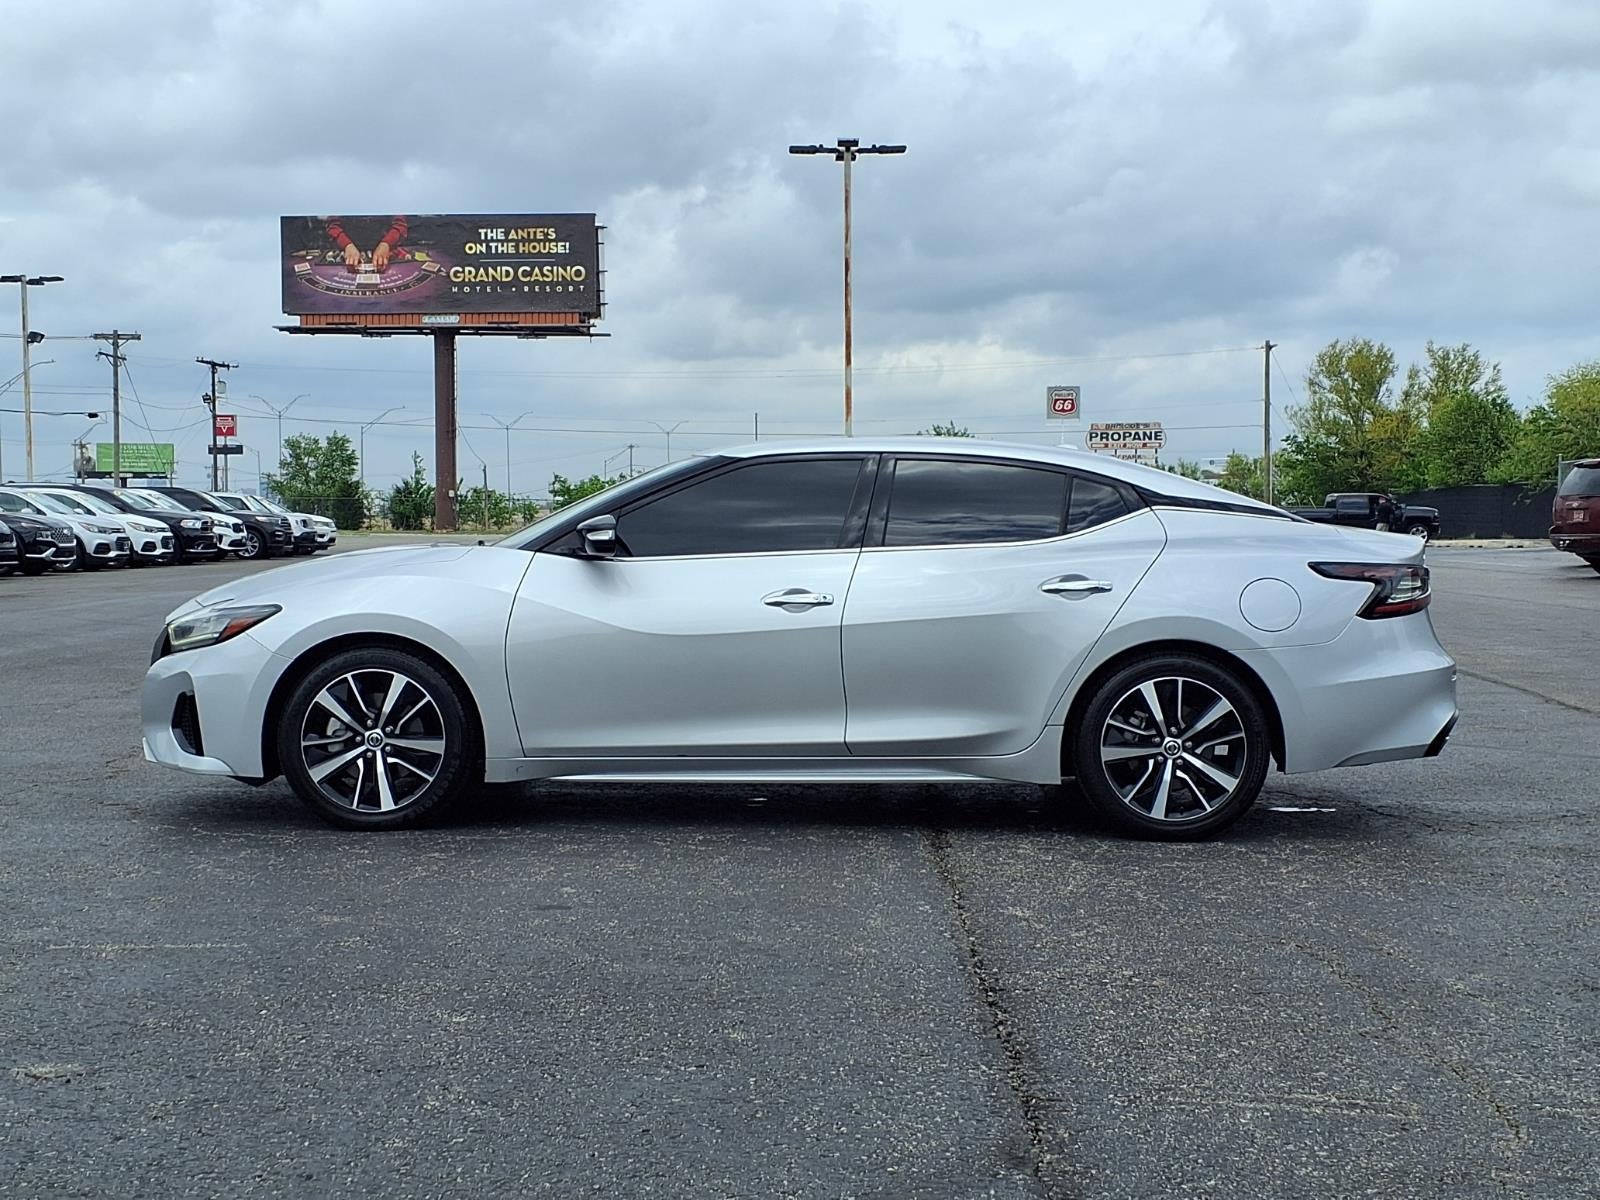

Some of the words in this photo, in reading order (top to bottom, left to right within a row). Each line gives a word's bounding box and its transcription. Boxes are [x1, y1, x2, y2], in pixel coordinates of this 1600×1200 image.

[478, 228, 505, 240] THE
[508, 228, 556, 239] ANTE'S
[465, 242, 486, 254] ON
[489, 242, 516, 254] THE
[519, 242, 570, 254] HOUSE!
[449, 266, 514, 282] GRAND
[517, 265, 586, 282] CASINO
[1055, 400, 1072, 410] 66
[1089, 431, 1163, 442] PROPANE
